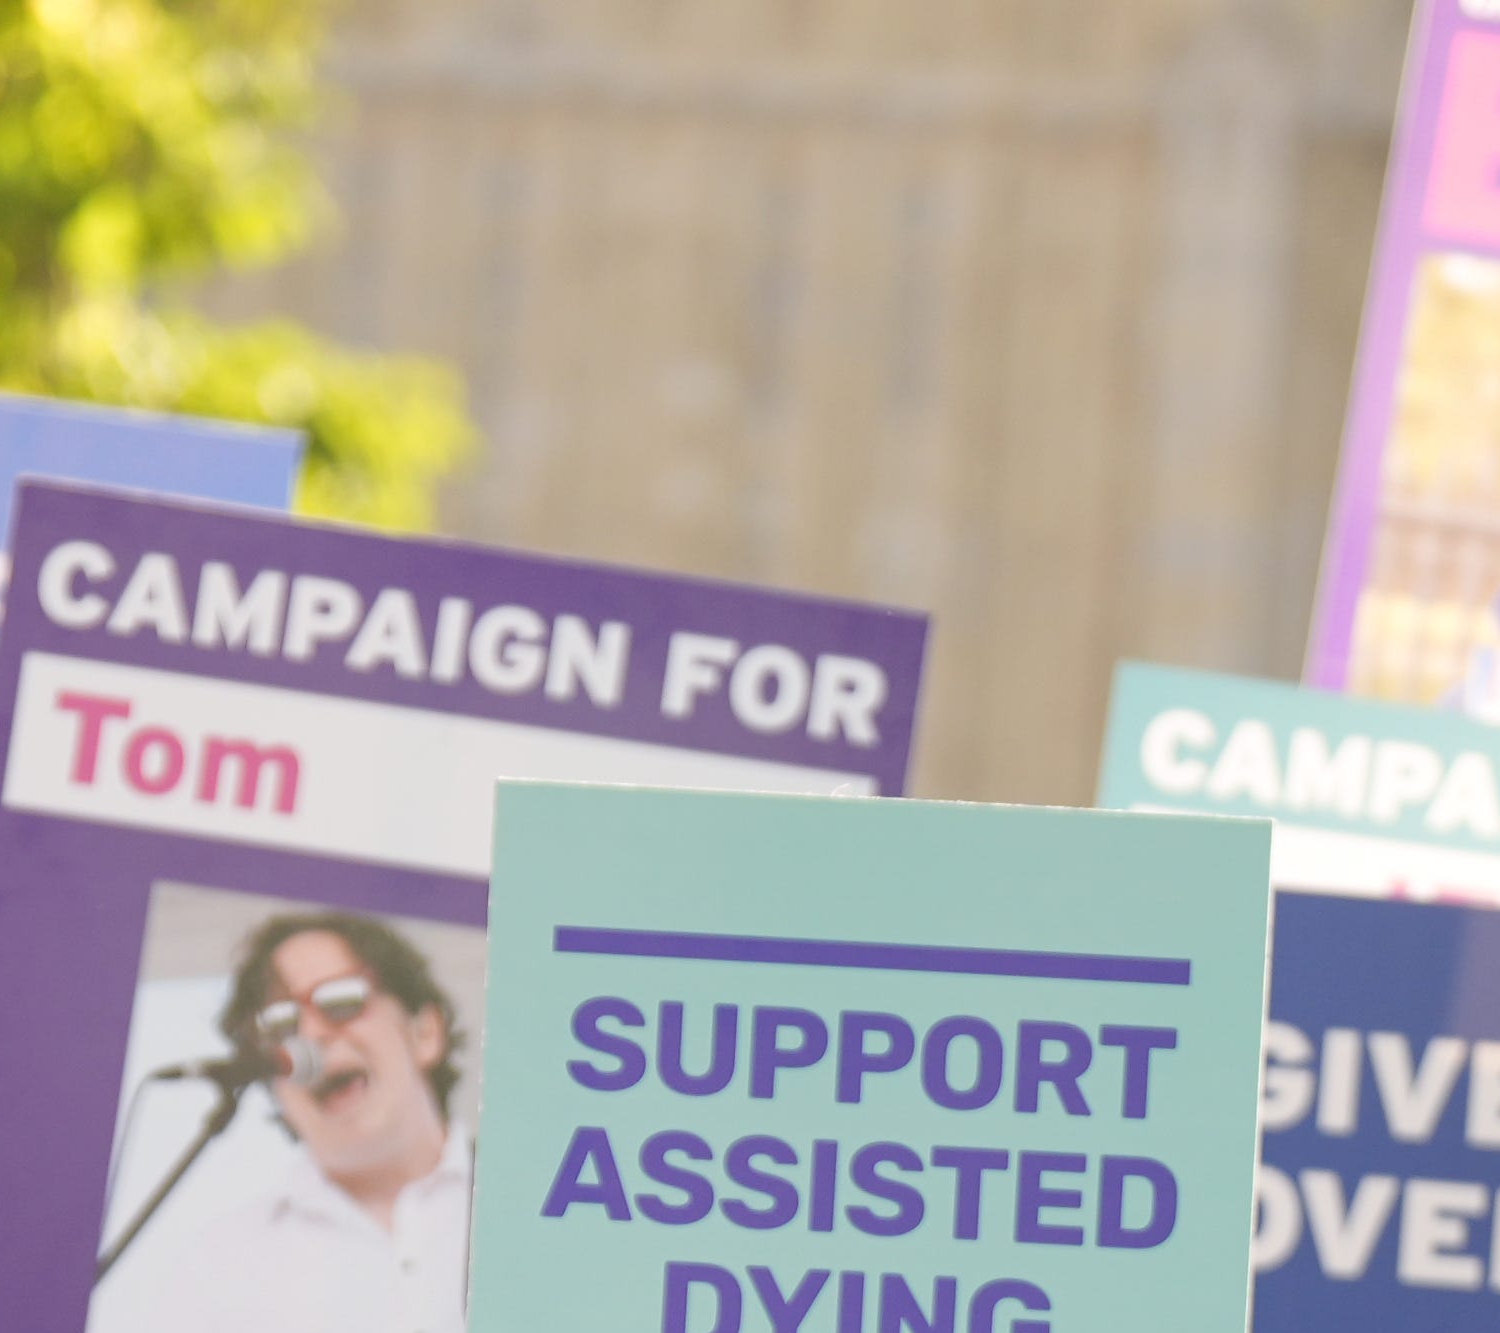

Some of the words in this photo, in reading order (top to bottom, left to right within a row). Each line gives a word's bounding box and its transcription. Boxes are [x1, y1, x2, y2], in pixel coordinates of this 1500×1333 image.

[36, 540, 632, 708] CAMPAIGN
[659, 630, 889, 748] FOR
[53, 687, 307, 815] Tom
[565, 994, 1179, 1121] SUPPORT
[539, 1124, 1180, 1250] ASSISTED
